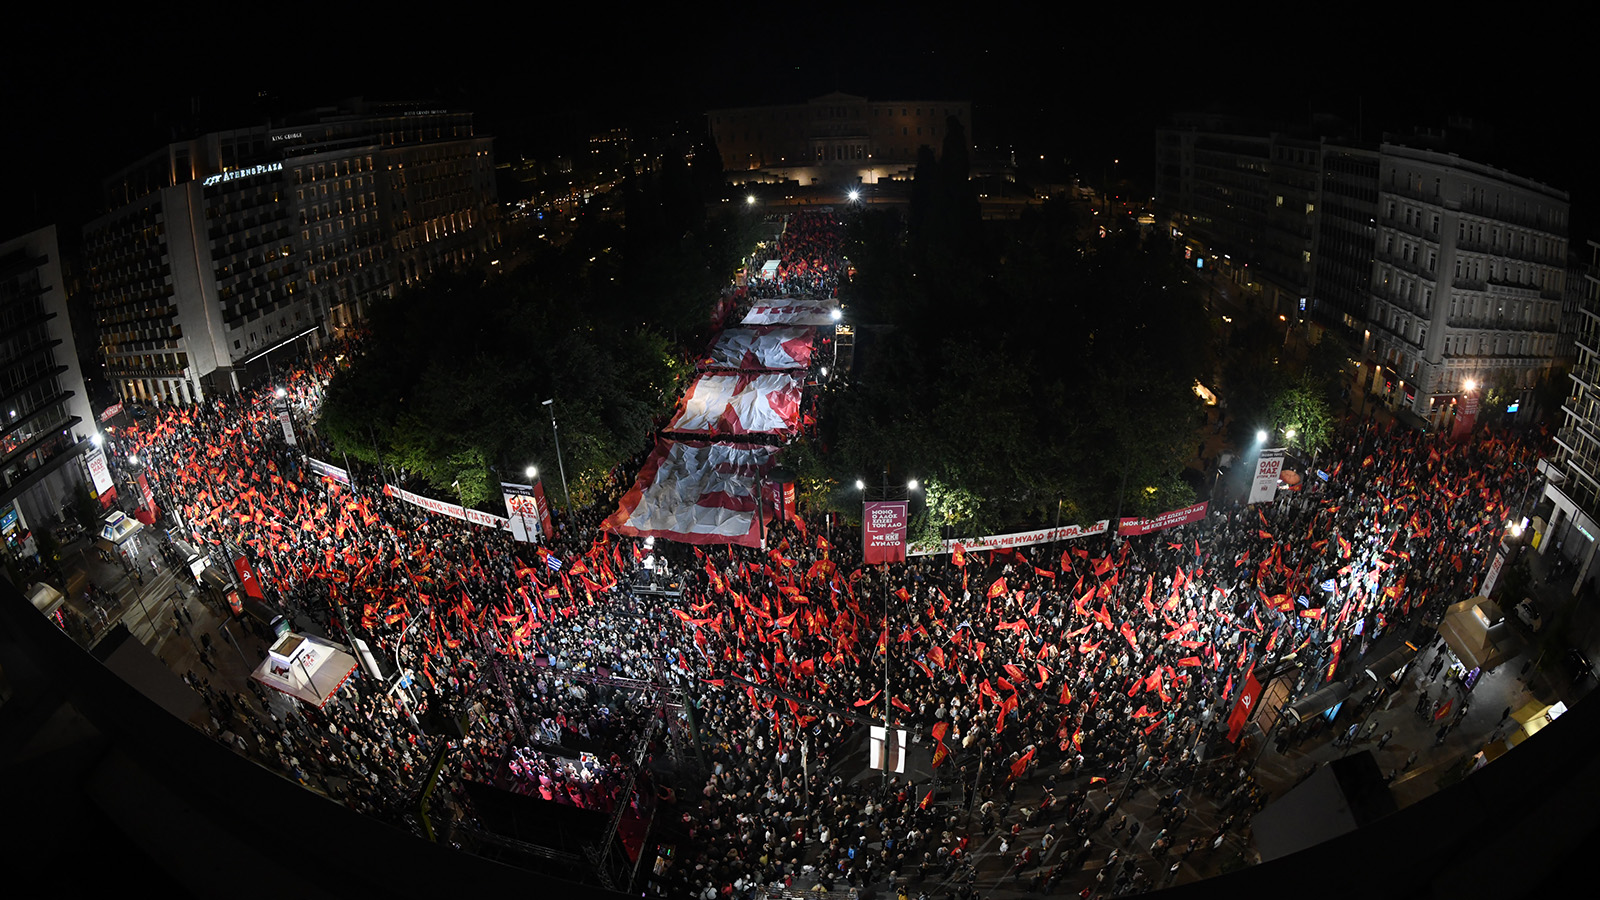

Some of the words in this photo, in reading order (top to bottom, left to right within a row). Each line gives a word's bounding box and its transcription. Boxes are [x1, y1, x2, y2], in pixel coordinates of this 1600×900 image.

[1260, 460, 1280, 468] ΟΛΟΙ
[1259, 467, 1278, 475] ΜΑΣ
[417, 497, 443, 511] ΔΥΝΑΤΟ
[467, 511, 479, 521] ΓΙΑ
[481, 514, 491, 524] ΤΟ
[1001, 537, 1014, 545] ΜΕ
[1015, 533, 1045, 544] ΜΥΑΛΟ
